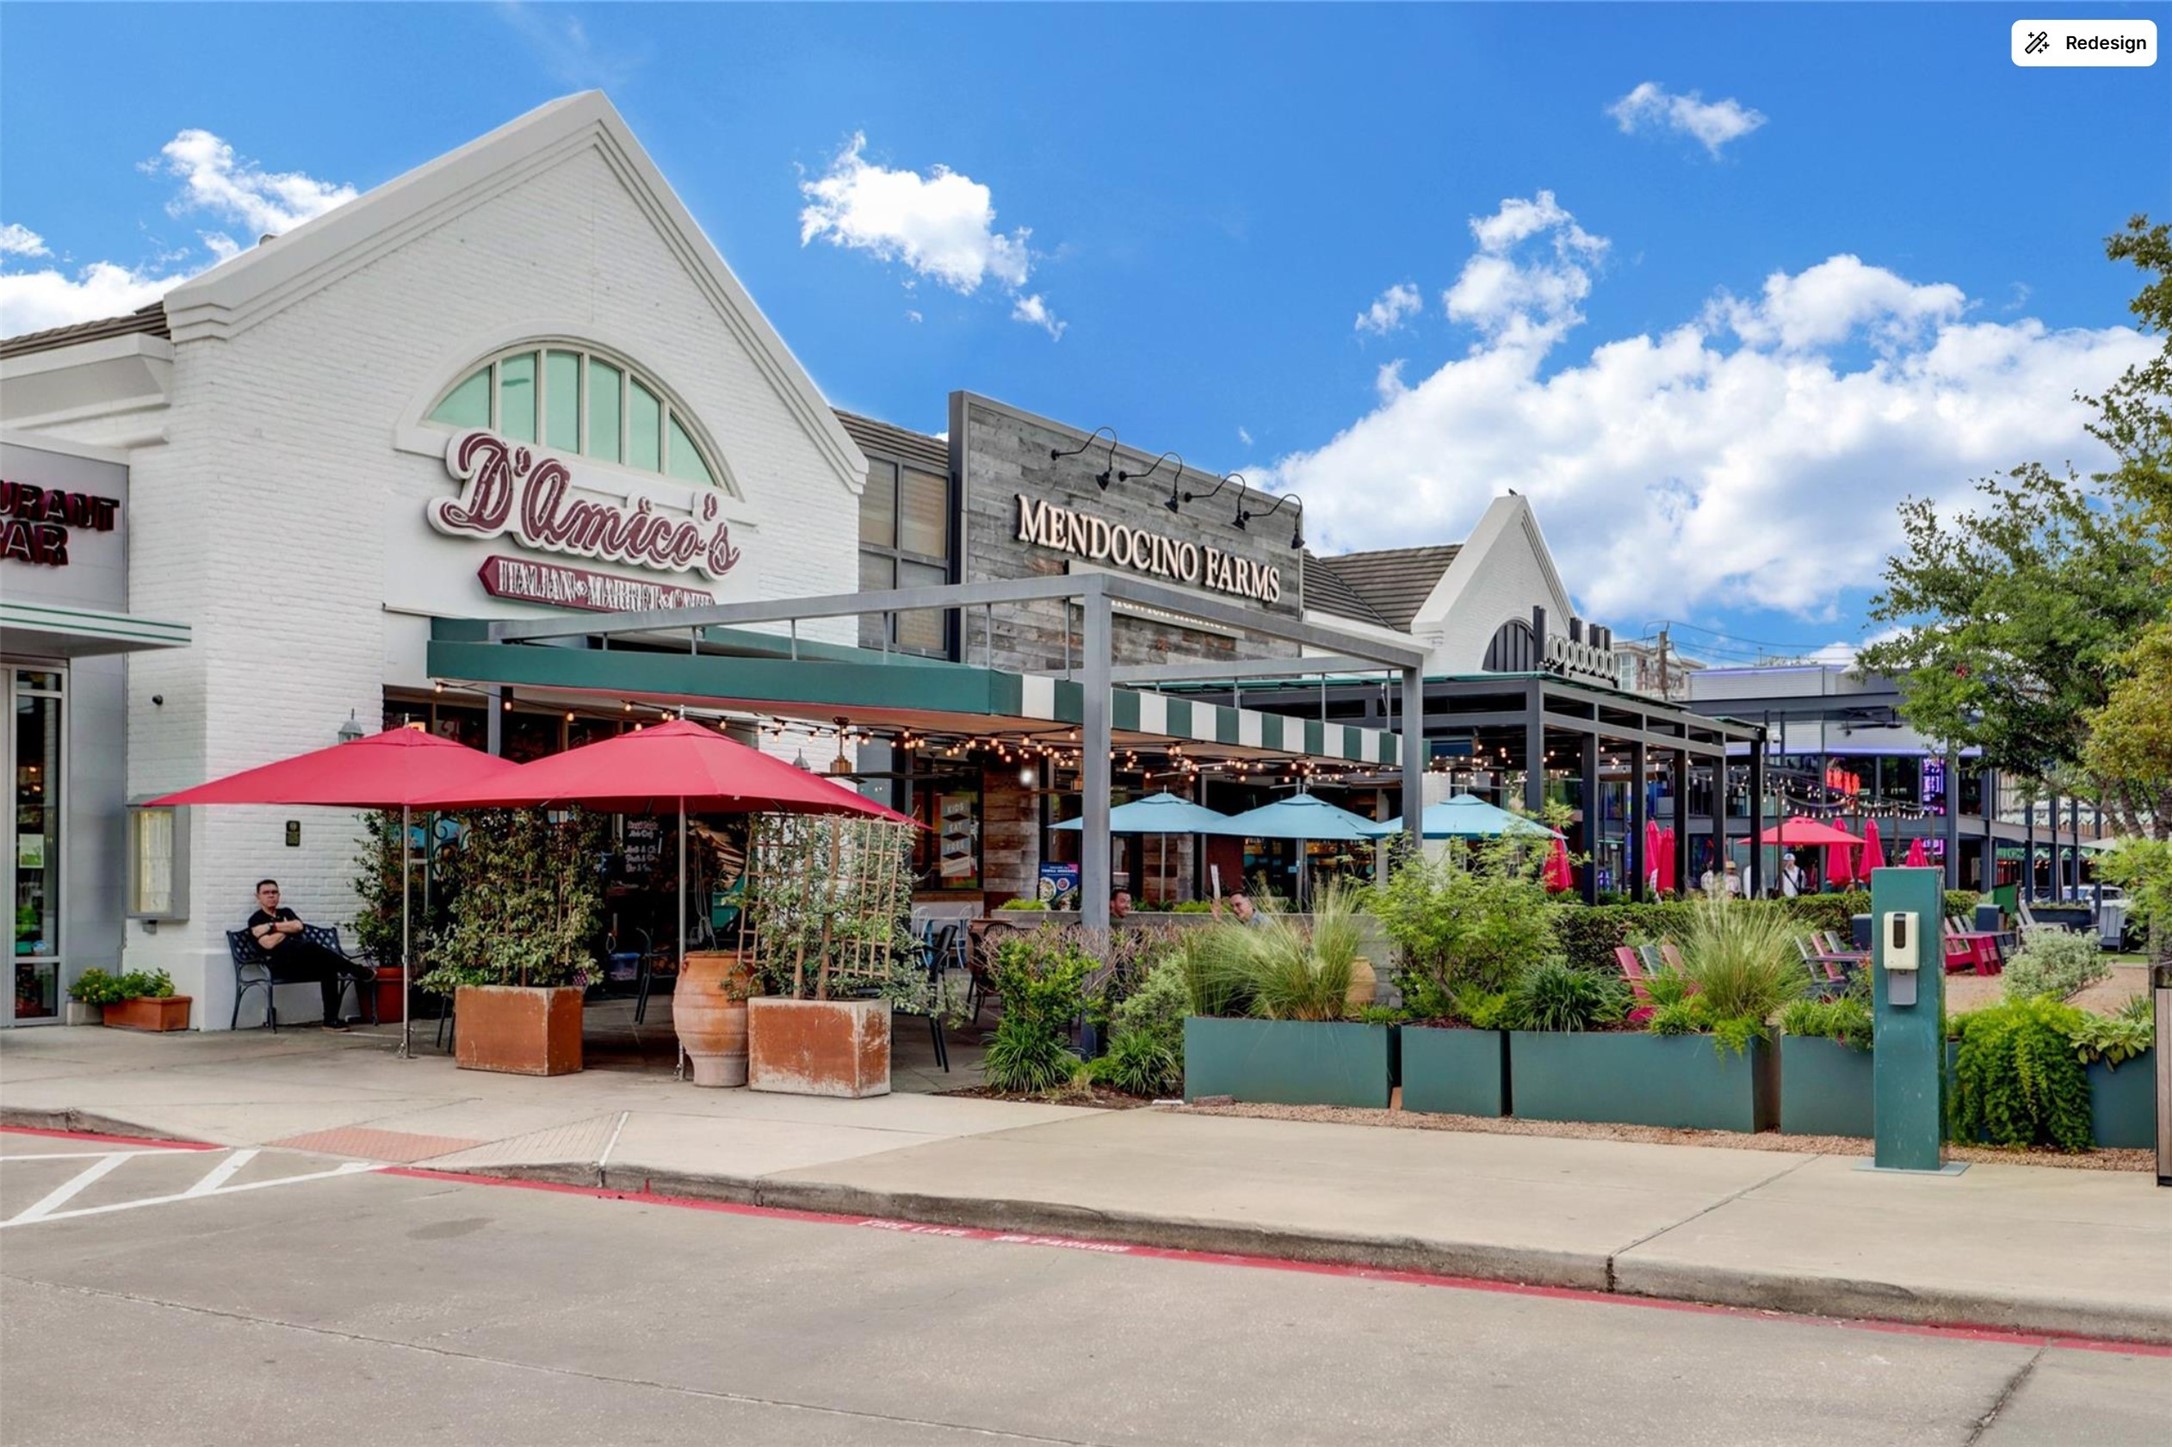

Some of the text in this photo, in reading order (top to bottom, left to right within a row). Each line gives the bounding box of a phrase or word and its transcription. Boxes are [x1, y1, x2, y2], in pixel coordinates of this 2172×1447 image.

[439, 432, 740, 576] D'Amico's
[0, 519, 69, 566] AR
[1016, 494, 1281, 603] MENDOCINO FARMS
[497, 559, 577, 603] ITALIAN
[946, 802, 965, 813] KIDS
[948, 821, 963, 833] EAT
[946, 840, 965, 853] FREE
[992, 1234, 1031, 1243] NO
[1030, 1237, 1132, 1253] PARKING
